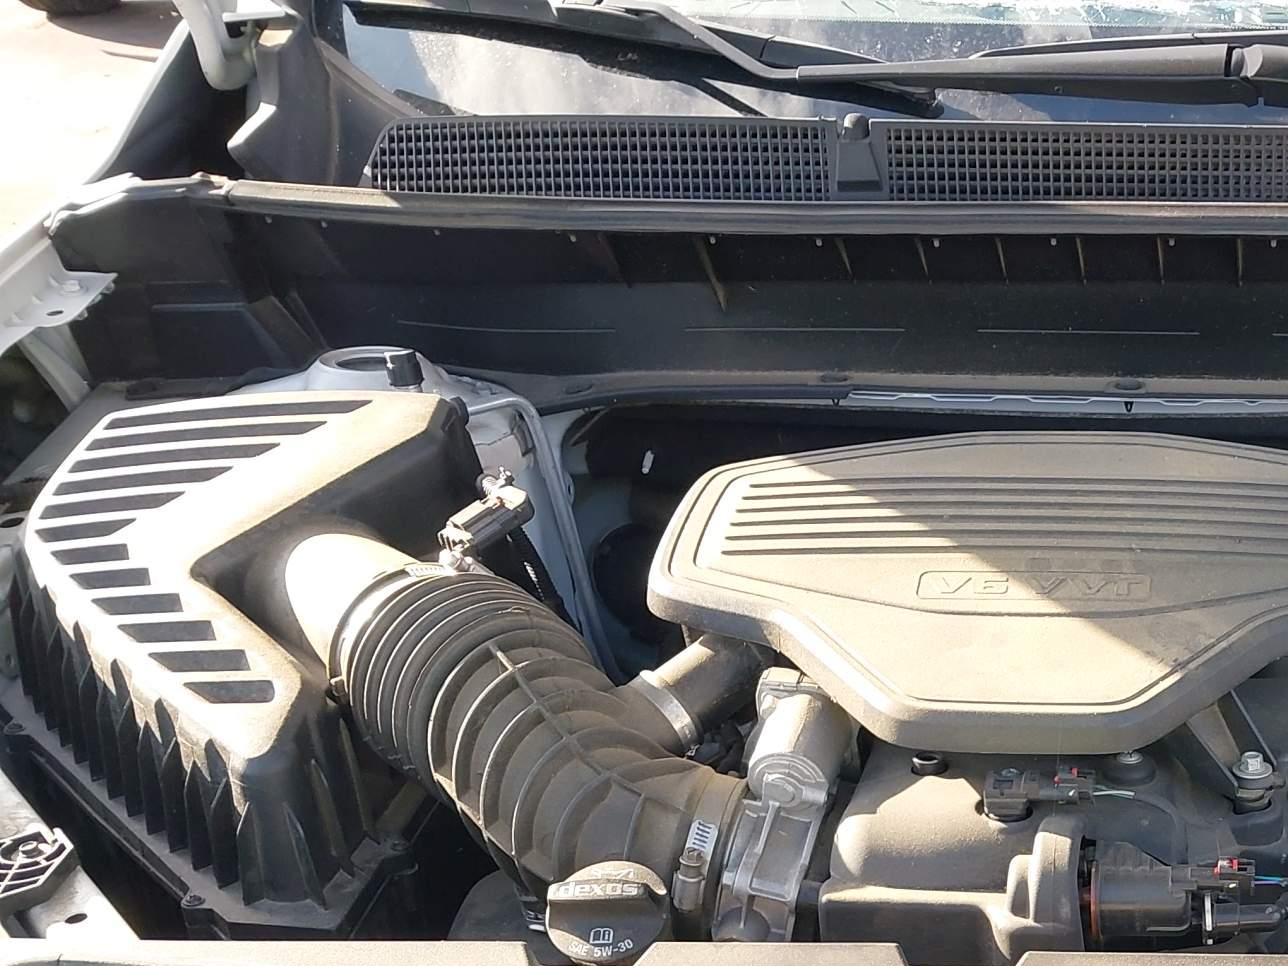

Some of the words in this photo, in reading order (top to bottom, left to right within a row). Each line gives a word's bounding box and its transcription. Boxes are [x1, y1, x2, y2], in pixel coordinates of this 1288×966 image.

[940, 576, 1009, 595] V6
[1031, 576, 1143, 596] VVT
[559, 881, 638, 896] dexos
[568, 940, 589, 957] SAE
[593, 939, 633, 957] 5W-30
